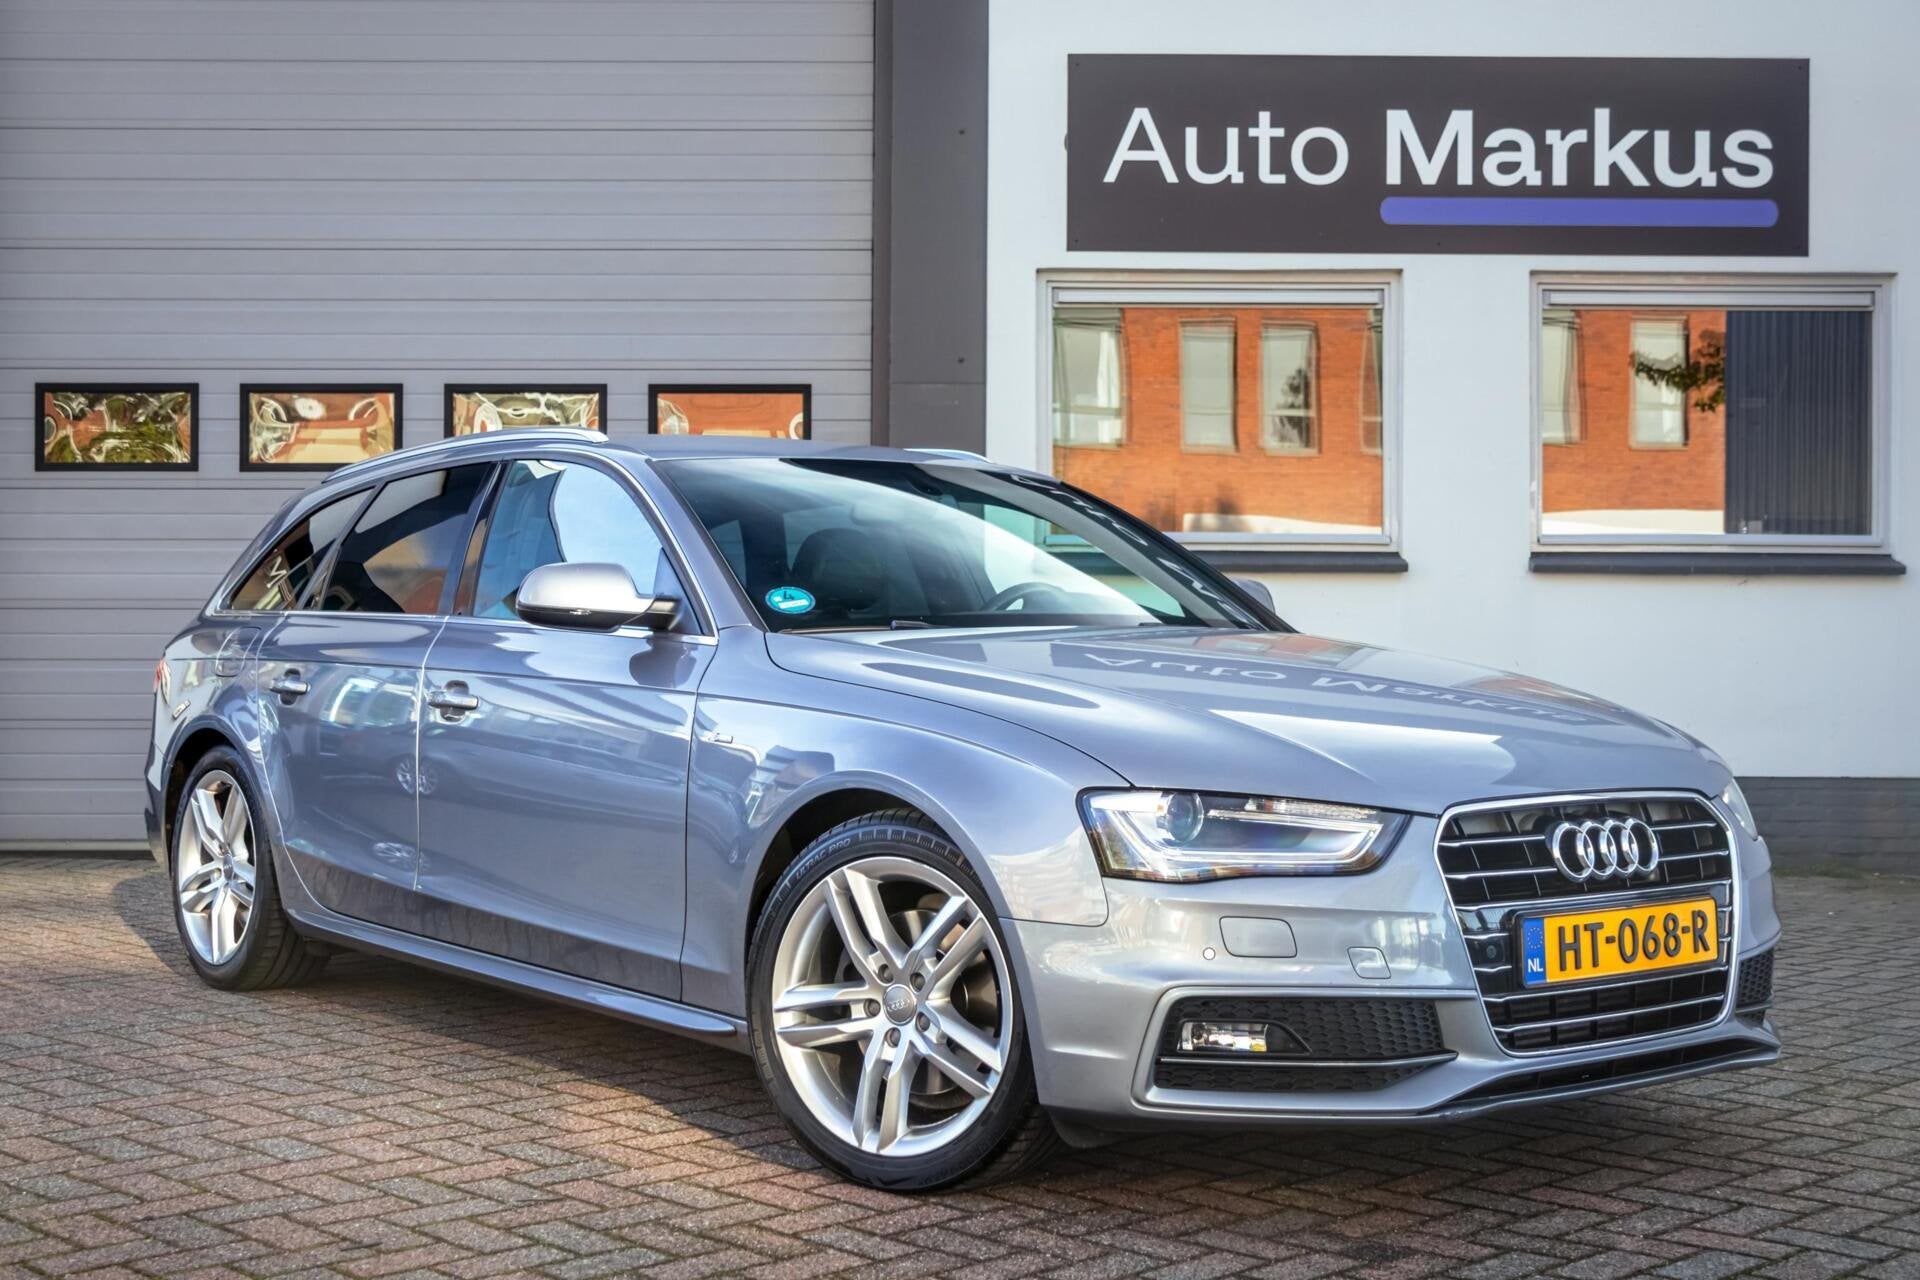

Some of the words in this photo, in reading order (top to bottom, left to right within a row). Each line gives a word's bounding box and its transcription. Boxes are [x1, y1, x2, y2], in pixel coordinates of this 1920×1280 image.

[1103, 107, 1349, 186] Auto
[1386, 107, 1773, 188] Markus
[1527, 958, 1544, 973] NL
[1558, 909, 1711, 972] HT-068-R
